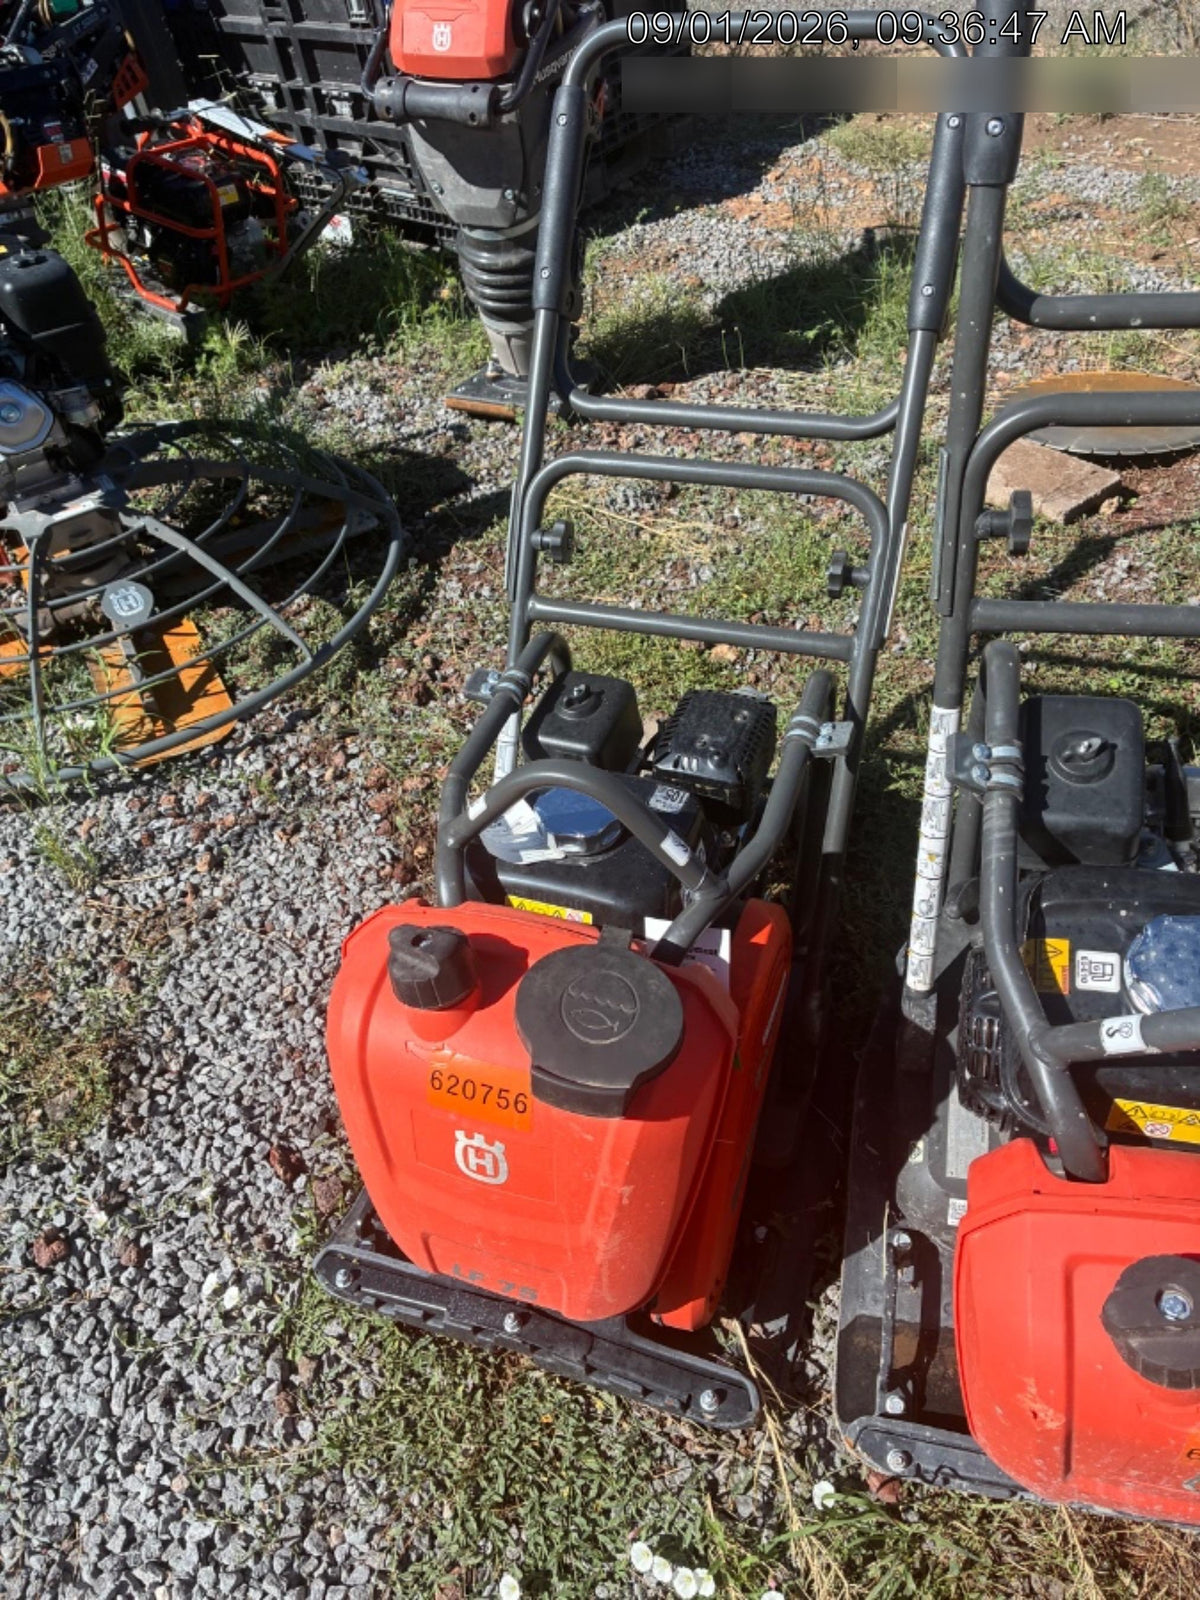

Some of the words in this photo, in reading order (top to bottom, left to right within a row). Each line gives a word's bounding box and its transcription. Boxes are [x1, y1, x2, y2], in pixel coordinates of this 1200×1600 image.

[533, 46, 576, 85] Husqvarn
[429, 1069, 529, 1114] 620756
[452, 1263, 484, 1284] LF
[497, 1280, 538, 1301] 75
